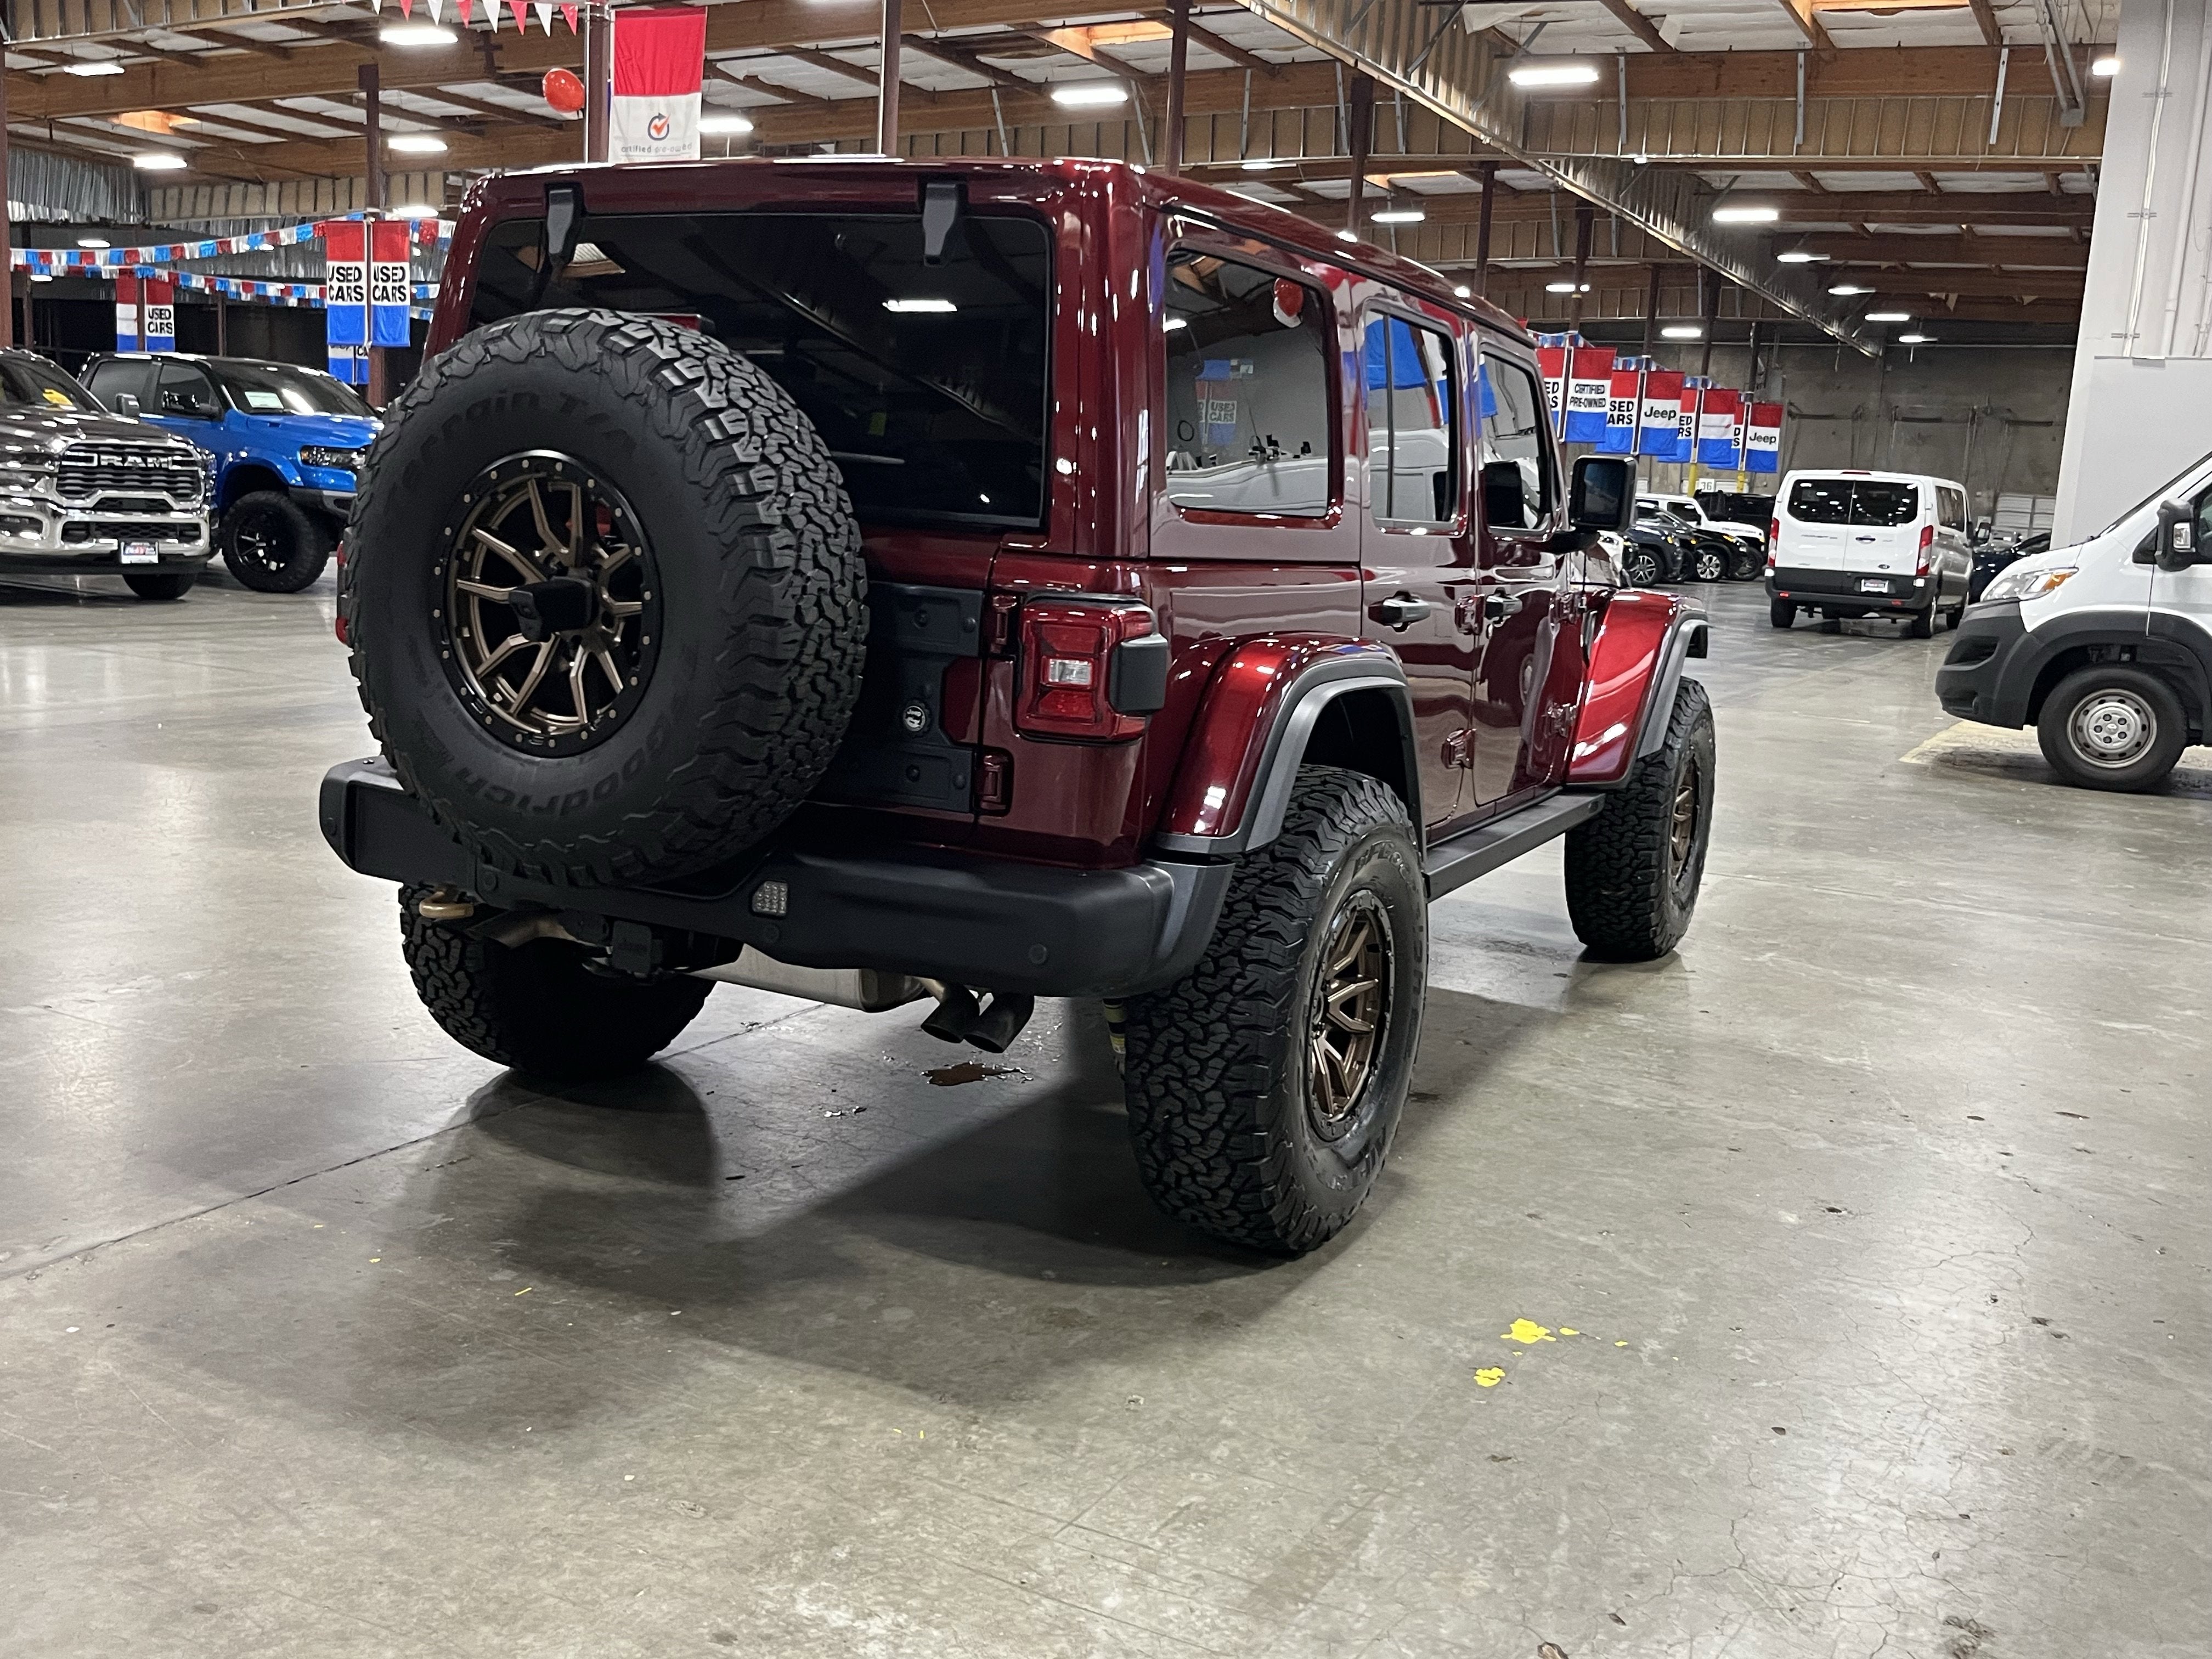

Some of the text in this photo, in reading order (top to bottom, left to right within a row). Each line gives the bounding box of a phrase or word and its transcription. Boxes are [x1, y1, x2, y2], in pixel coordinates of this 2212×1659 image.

[328, 265, 362, 283] USED
[374, 266, 405, 283] USED
[329, 284, 364, 302] CARS
[373, 285, 406, 302] CARS
[148, 308, 172, 320] USED
[1545, 382, 1559, 394] ED
[1570, 396, 1606, 408] PRE-OWNED
[1609, 400, 1634, 412] SED
[1607, 414, 1633, 425] ARS
[1644, 407, 1677, 420] Jeep
[1679, 416, 1692, 426] ED
[1678, 427, 1691, 437] RS
[1749, 433, 1776, 444] Jeep
[100, 455, 168, 467] RAM
[1701, 482, 1712, 490] 36
